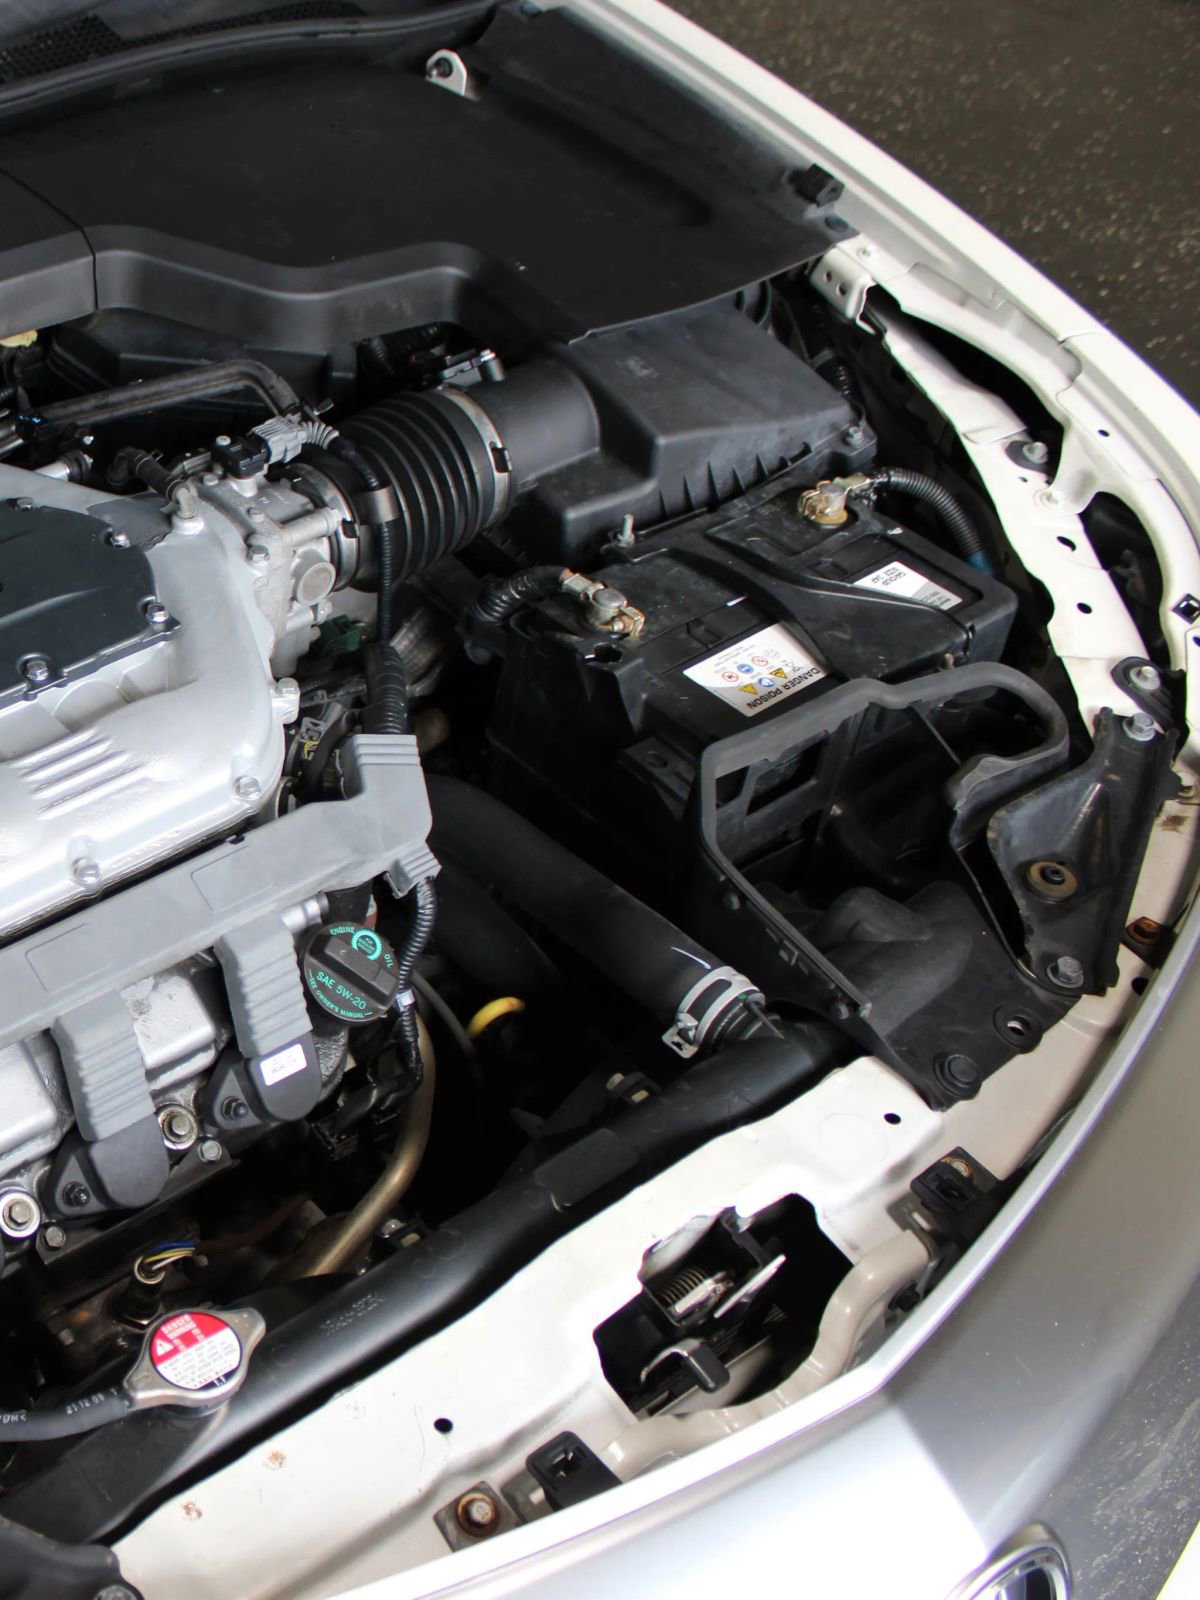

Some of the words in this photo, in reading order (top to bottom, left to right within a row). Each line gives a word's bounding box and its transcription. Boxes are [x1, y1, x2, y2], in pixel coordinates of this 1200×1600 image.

[781, 667, 820, 690] DANGER
[746, 688, 783, 710] POISON
[330, 926, 355, 936] ENGINE
[384, 954, 394, 968] OIL
[316, 971, 336, 989] SAE
[335, 985, 366, 1010] 5W-20
[316, 990, 339, 1012] OWNER'S
[340, 1009, 365, 1018] MANUAL
